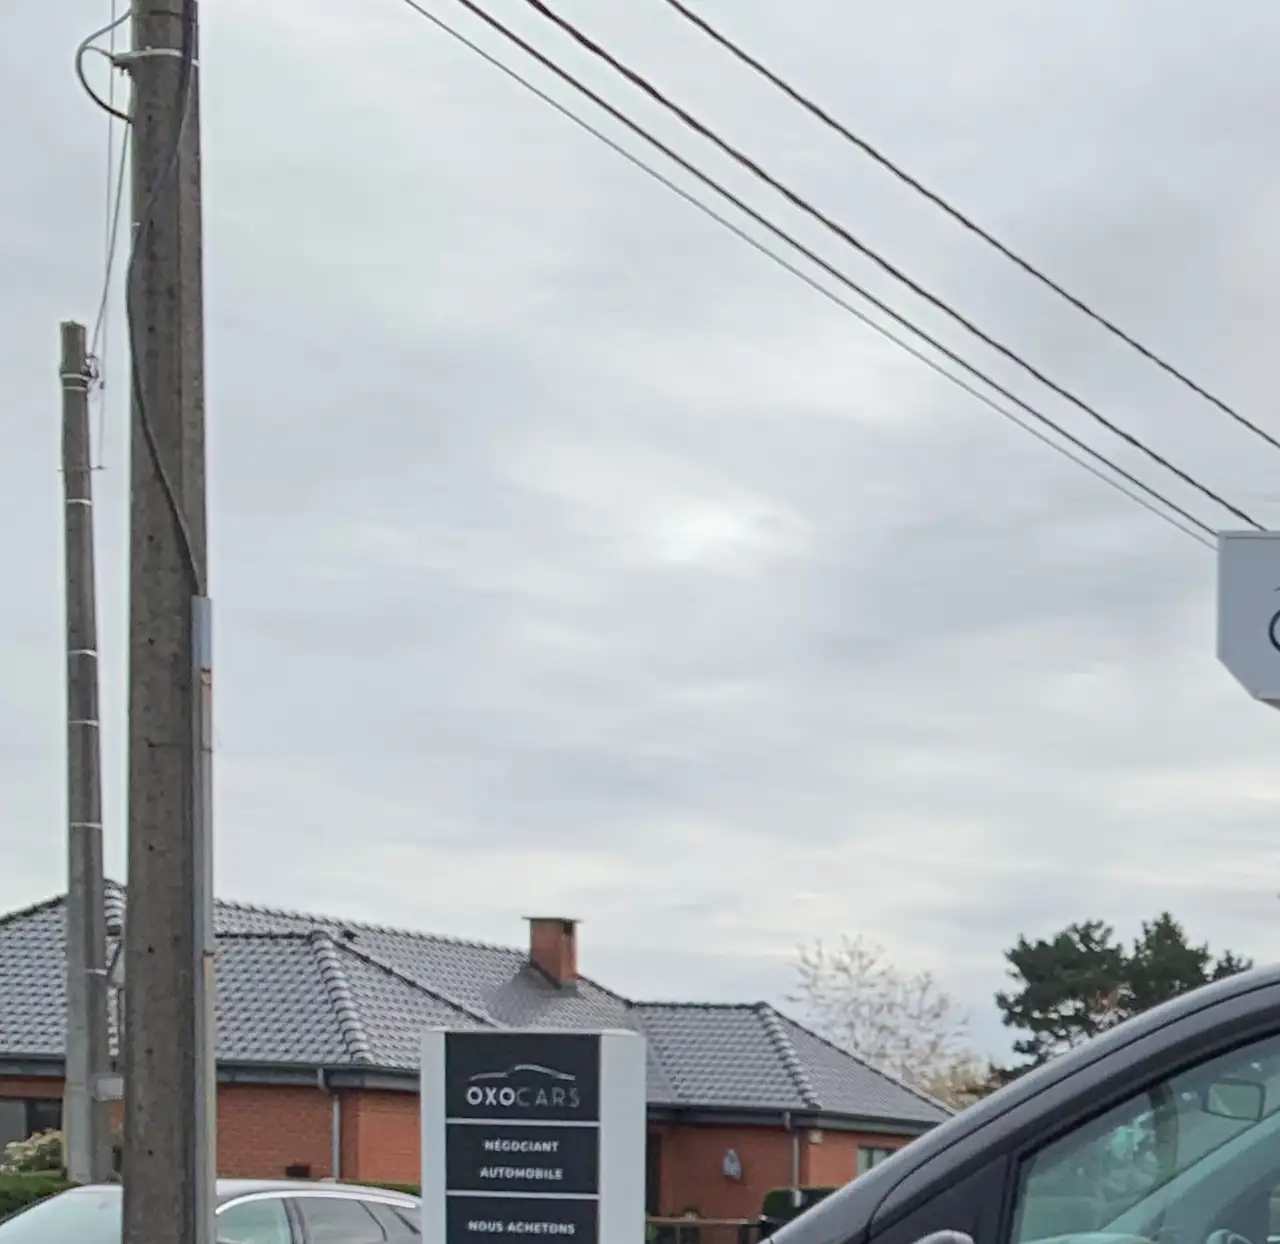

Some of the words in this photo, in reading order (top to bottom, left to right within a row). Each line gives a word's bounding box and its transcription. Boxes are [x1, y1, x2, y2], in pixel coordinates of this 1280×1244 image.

[466, 1086, 580, 1108] OXOCARS
[480, 1166, 564, 1181] AUTOMOBILE
[467, 1219, 503, 1233] NOUS
[507, 1221, 576, 1235] ACHETONS
